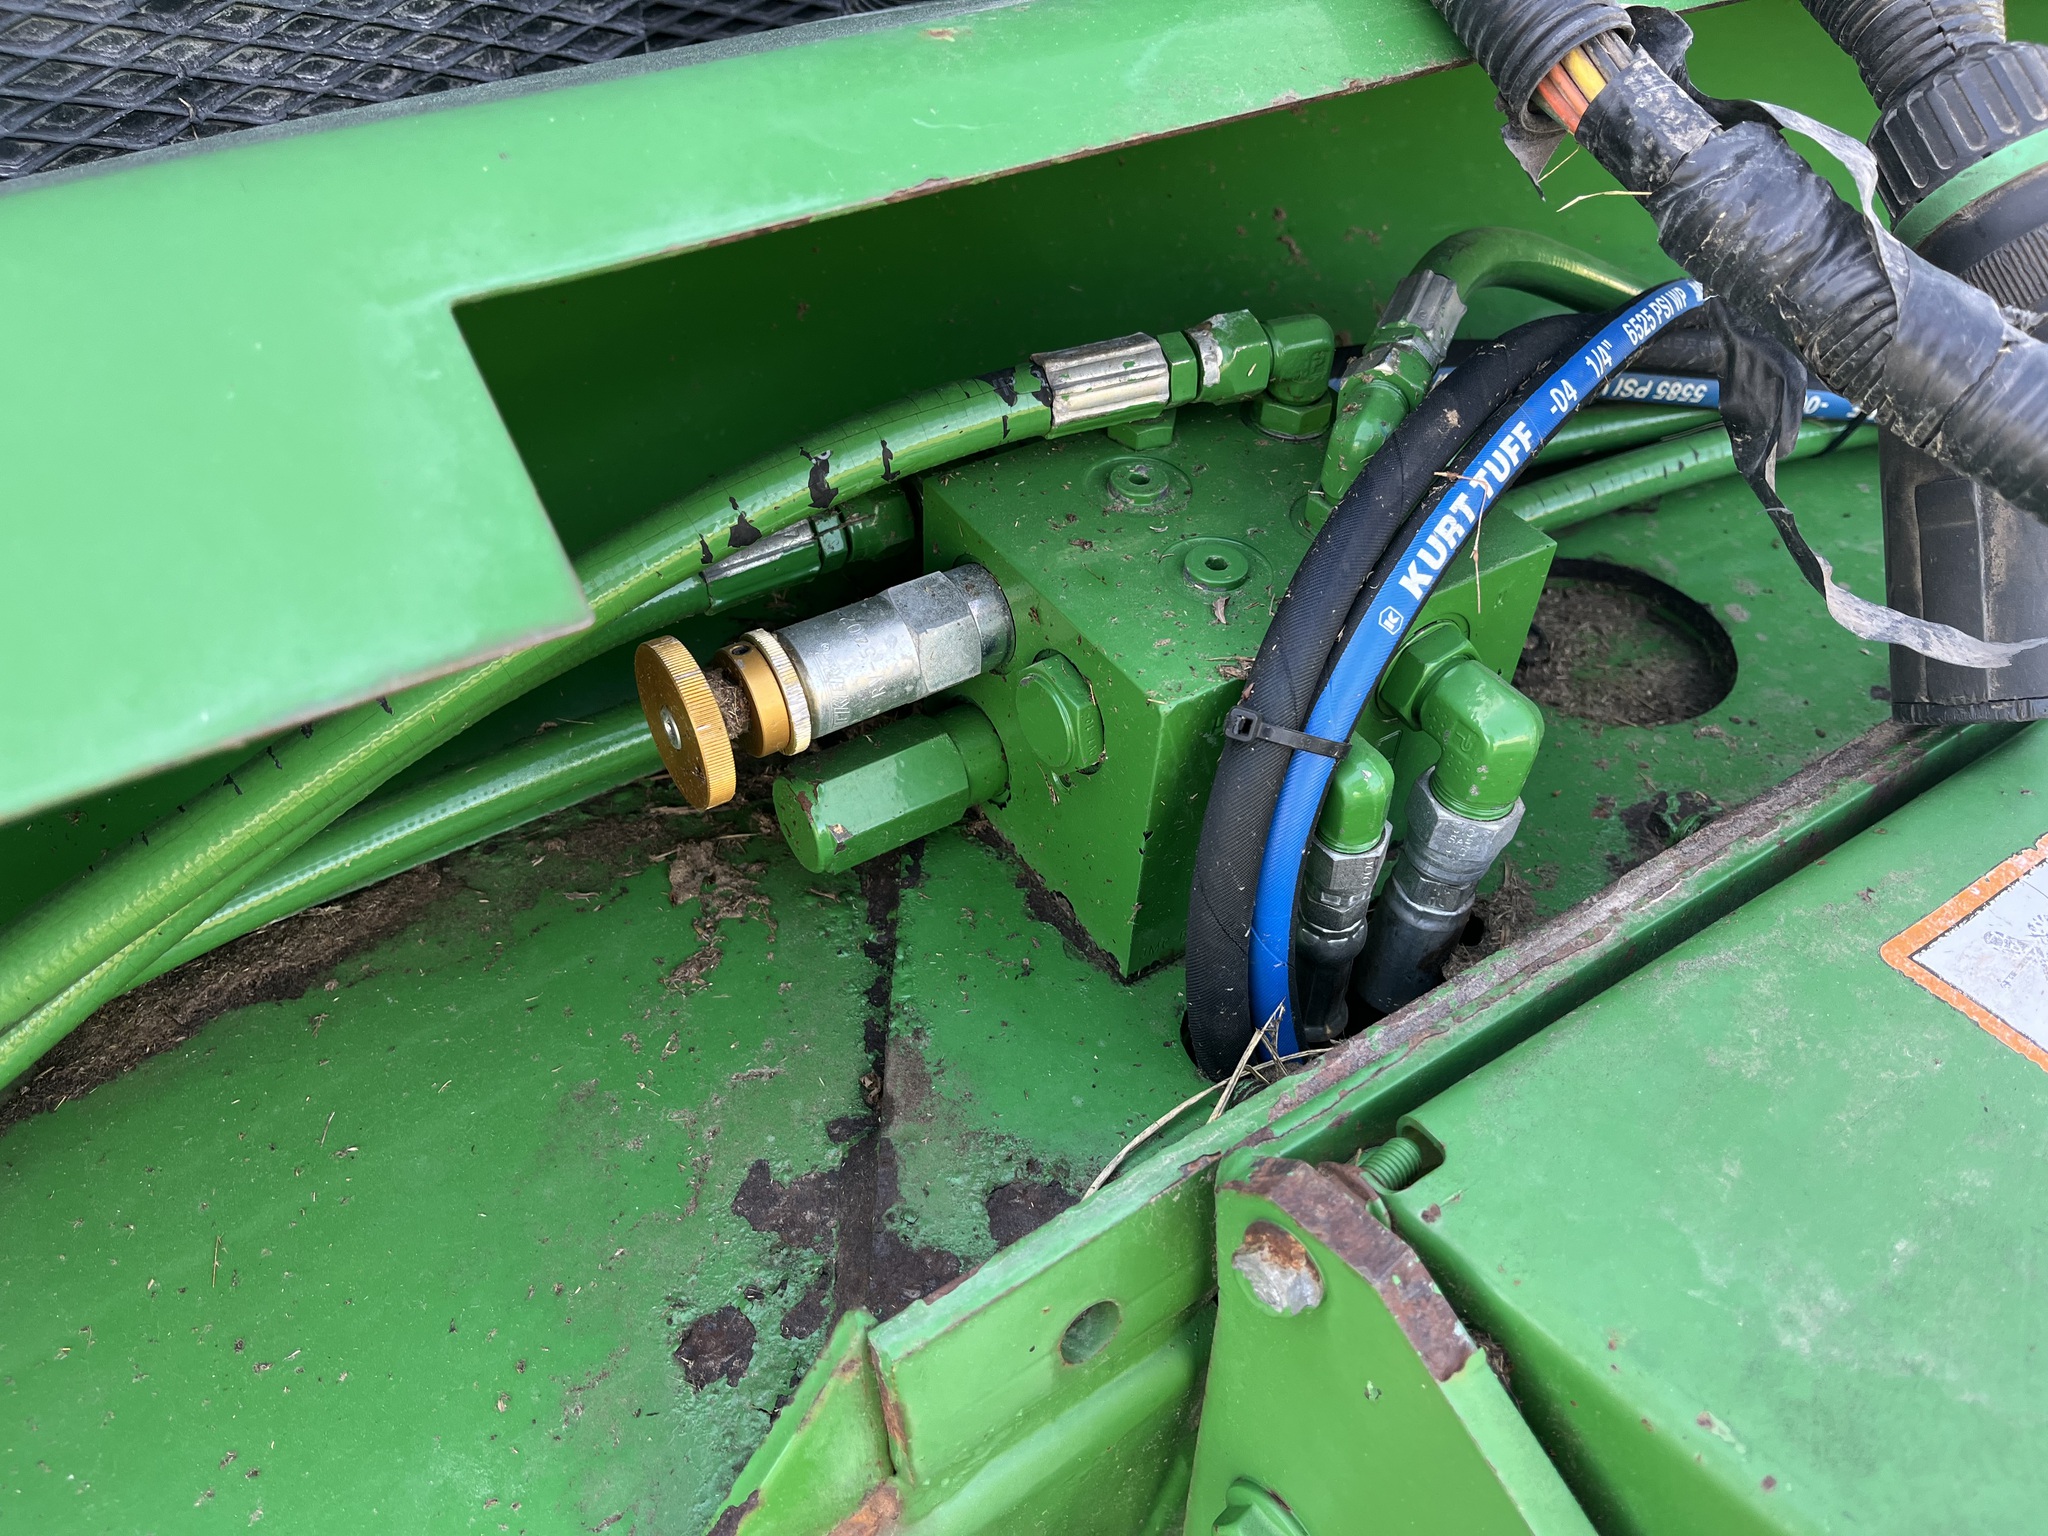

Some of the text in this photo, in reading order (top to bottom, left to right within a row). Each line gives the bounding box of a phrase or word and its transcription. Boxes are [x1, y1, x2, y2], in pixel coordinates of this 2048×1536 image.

[1612, 377, 1654, 400] PSI
[1652, 381, 1708, 403] 5585
[1398, 492, 1477, 601] KURT
[1469, 420, 1536, 499] TUFF
[1549, 378, 1578, 415] -04
[1584, 339, 1613, 379] 1/4"
[1622, 309, 1657, 346] 6525
[1652, 295, 1675, 325] PSI
[1665, 287, 1687, 312] WP
